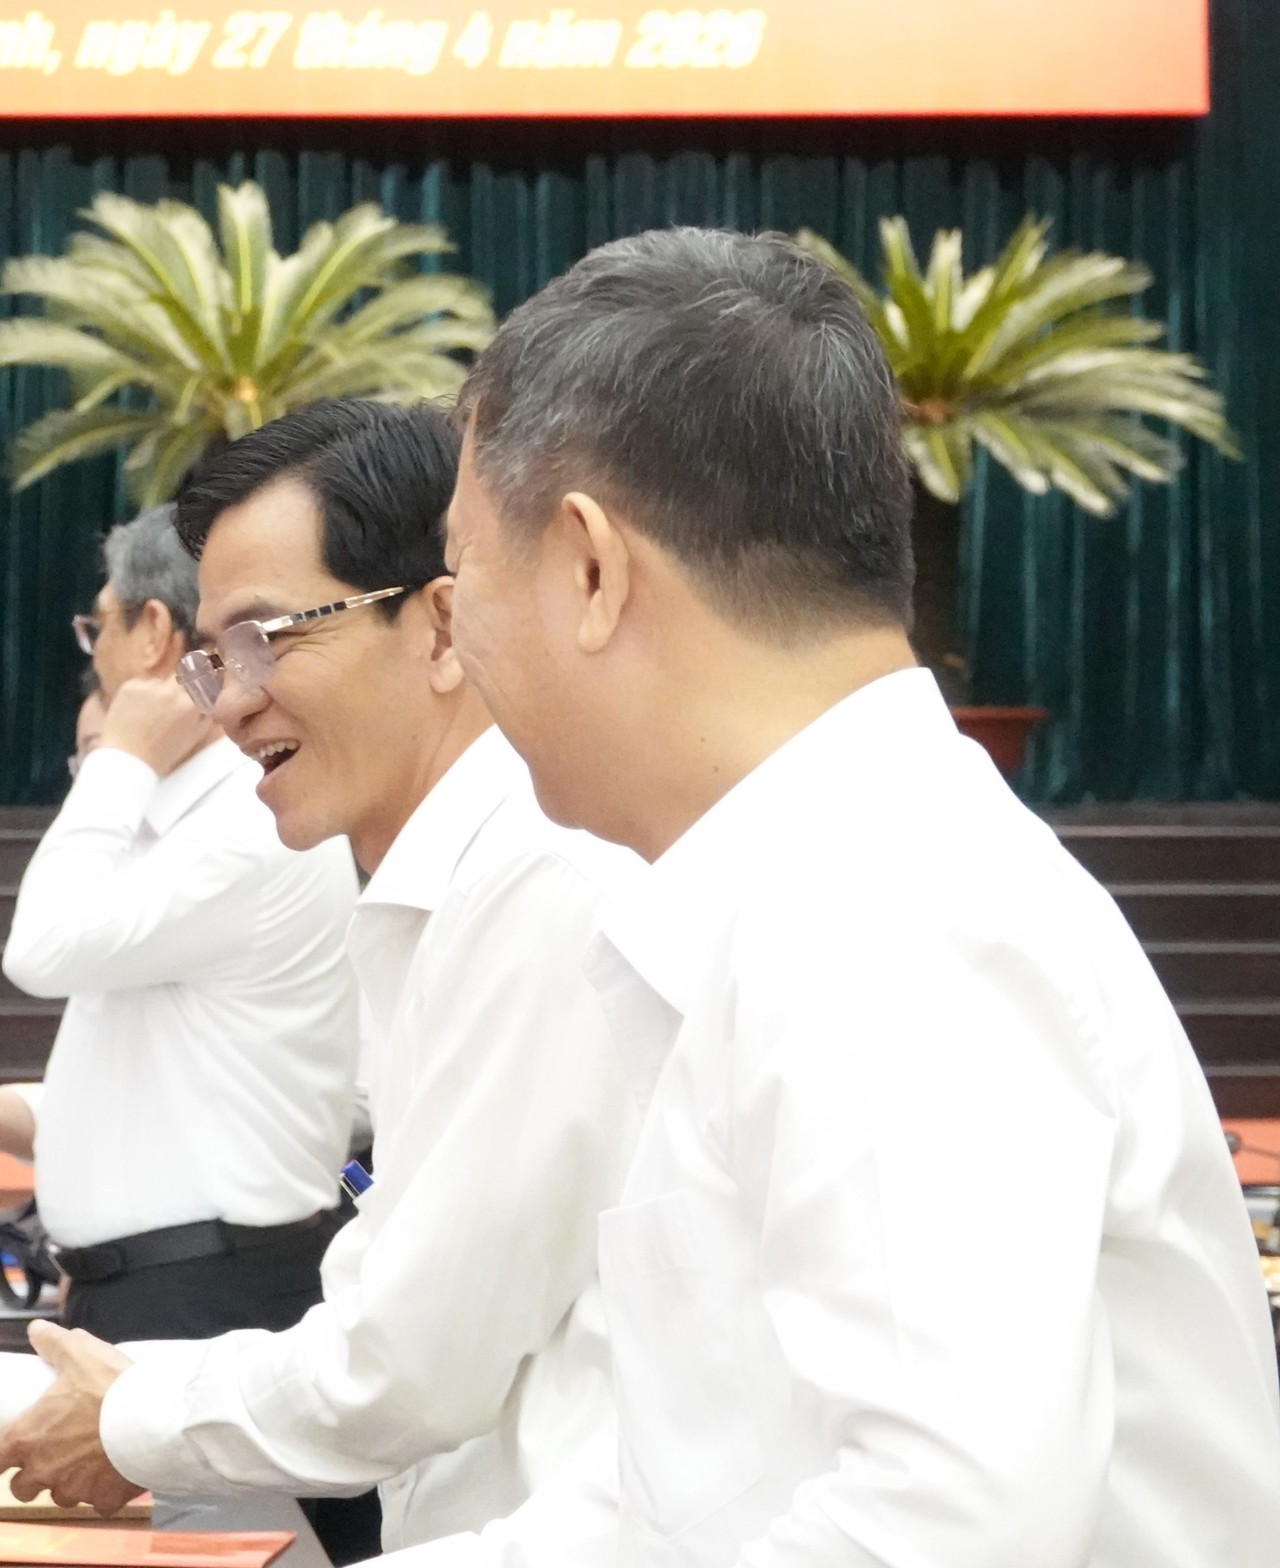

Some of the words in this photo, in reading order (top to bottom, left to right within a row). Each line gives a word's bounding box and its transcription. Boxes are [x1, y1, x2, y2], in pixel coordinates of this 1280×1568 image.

[74, 10, 211, 75] ngày
[212, 10, 293, 68] 27
[293, 10, 449, 76] tháng
[452, 10, 494, 68] 4
[498, 10, 623, 69] năm
[625, 9, 767, 68] 2026
